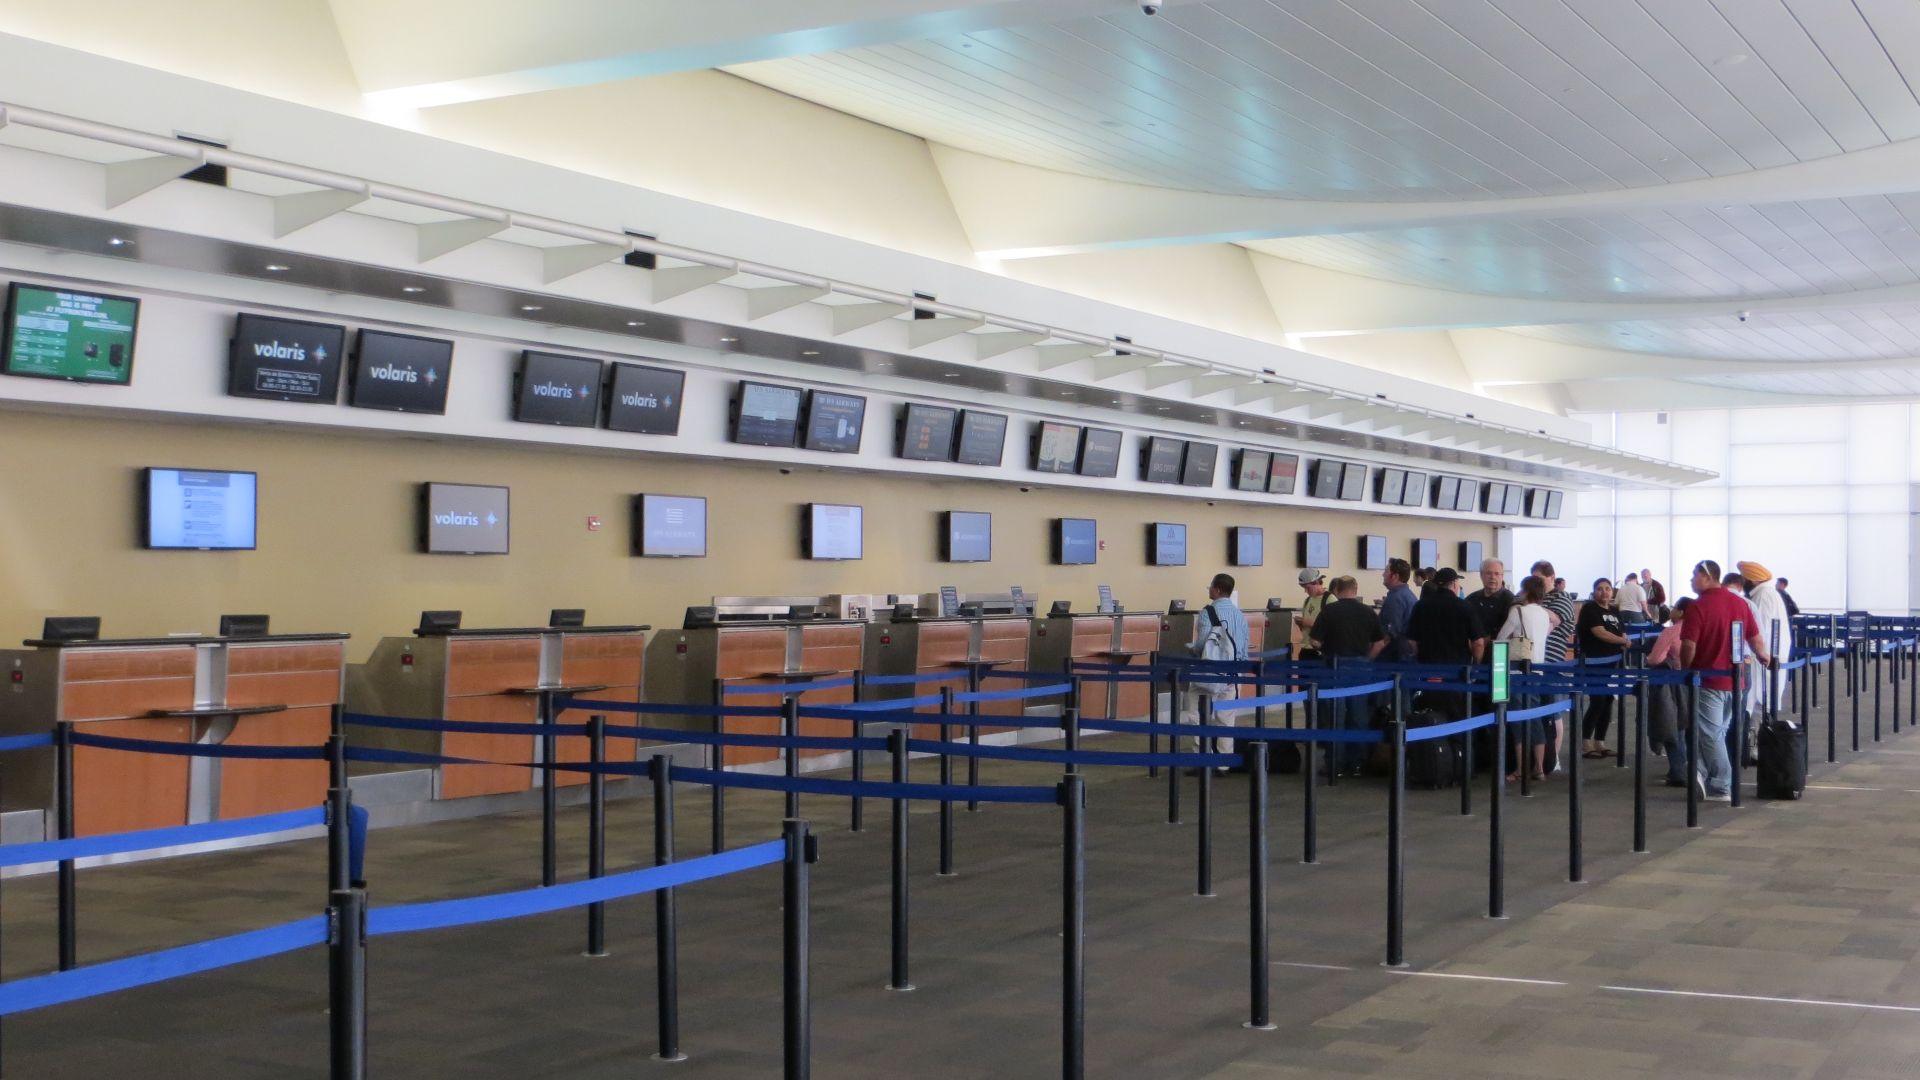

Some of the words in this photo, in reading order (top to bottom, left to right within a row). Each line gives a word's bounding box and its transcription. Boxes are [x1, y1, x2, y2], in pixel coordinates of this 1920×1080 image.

[254, 341, 305, 360] volaris
[370, 363, 418, 383] volaris
[533, 381, 573, 398] volaris
[622, 391, 657, 408] volaris
[434, 511, 479, 526] volaris
